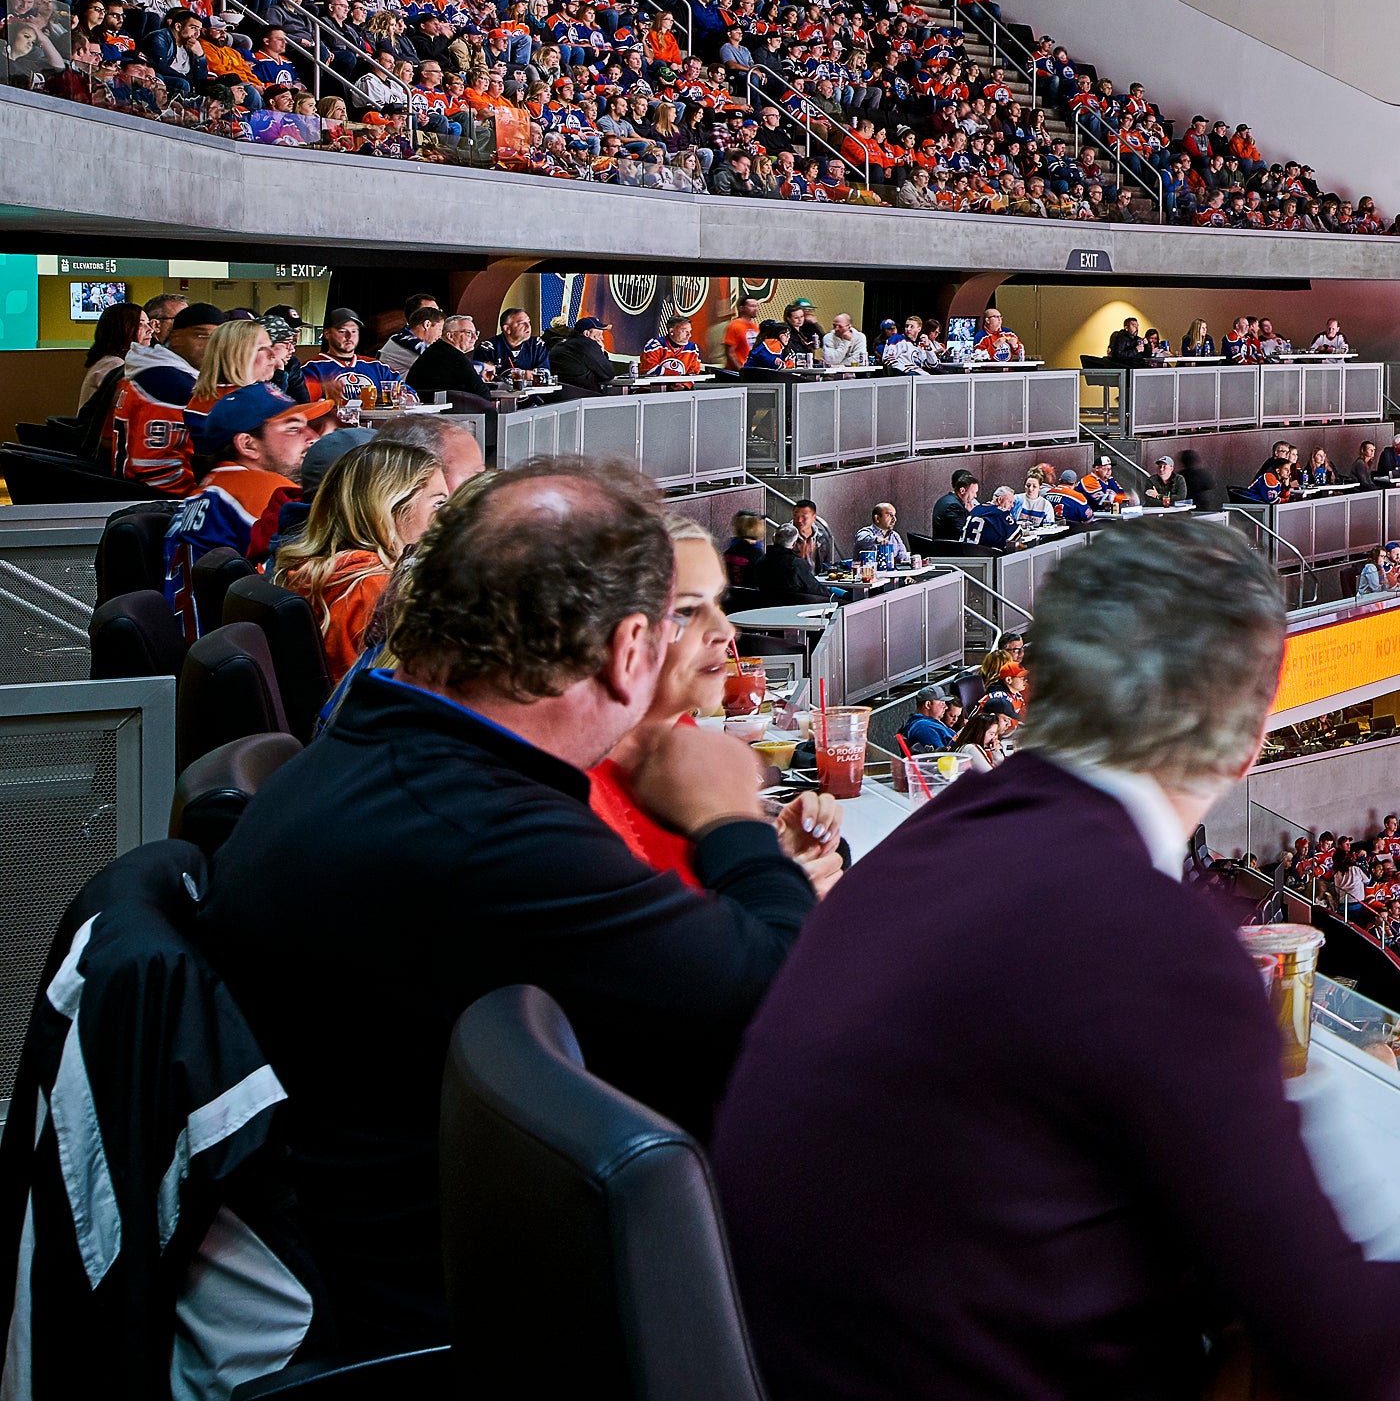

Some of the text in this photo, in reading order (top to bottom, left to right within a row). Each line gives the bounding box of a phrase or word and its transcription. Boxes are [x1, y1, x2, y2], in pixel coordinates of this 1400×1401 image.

[72, 262, 104, 270] ELEVATORS
[110, 260, 117, 273] 5
[1080, 253, 1098, 268] EXIT
[280, 264, 286, 276] 5
[291, 264, 317, 277] EXIT
